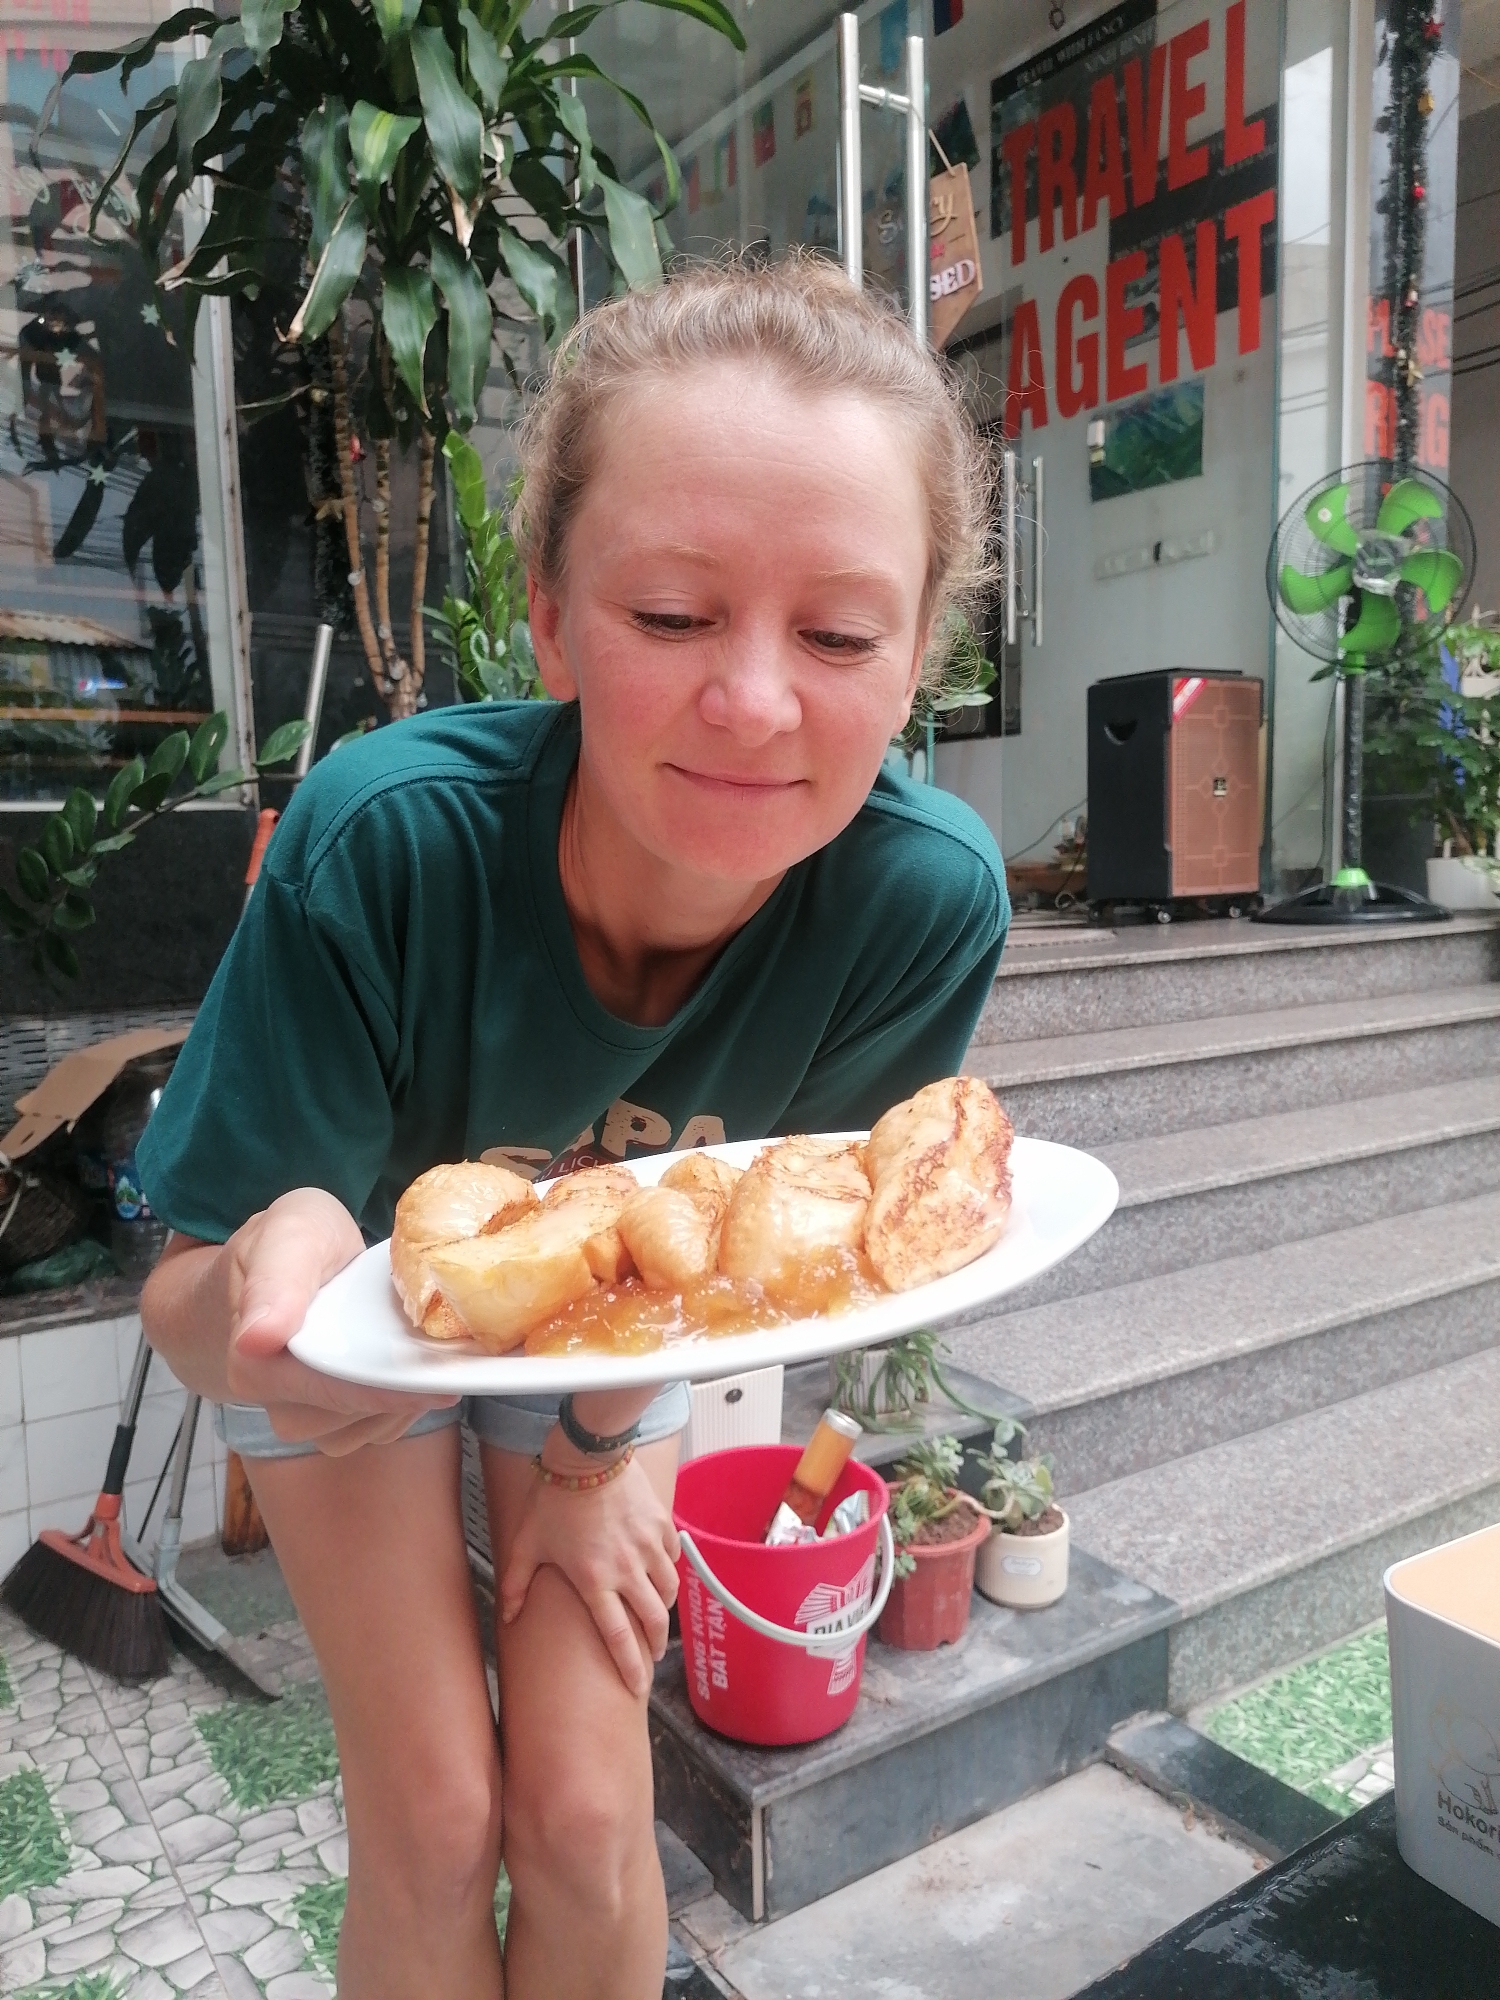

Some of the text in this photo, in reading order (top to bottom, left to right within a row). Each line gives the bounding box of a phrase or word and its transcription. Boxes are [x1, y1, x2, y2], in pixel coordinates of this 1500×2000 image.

[1000, 2, 1266, 266] TRAVEL
[1003, 190, 1275, 440] AGENT
[1437, 1790, 1500, 1843] Hokor
